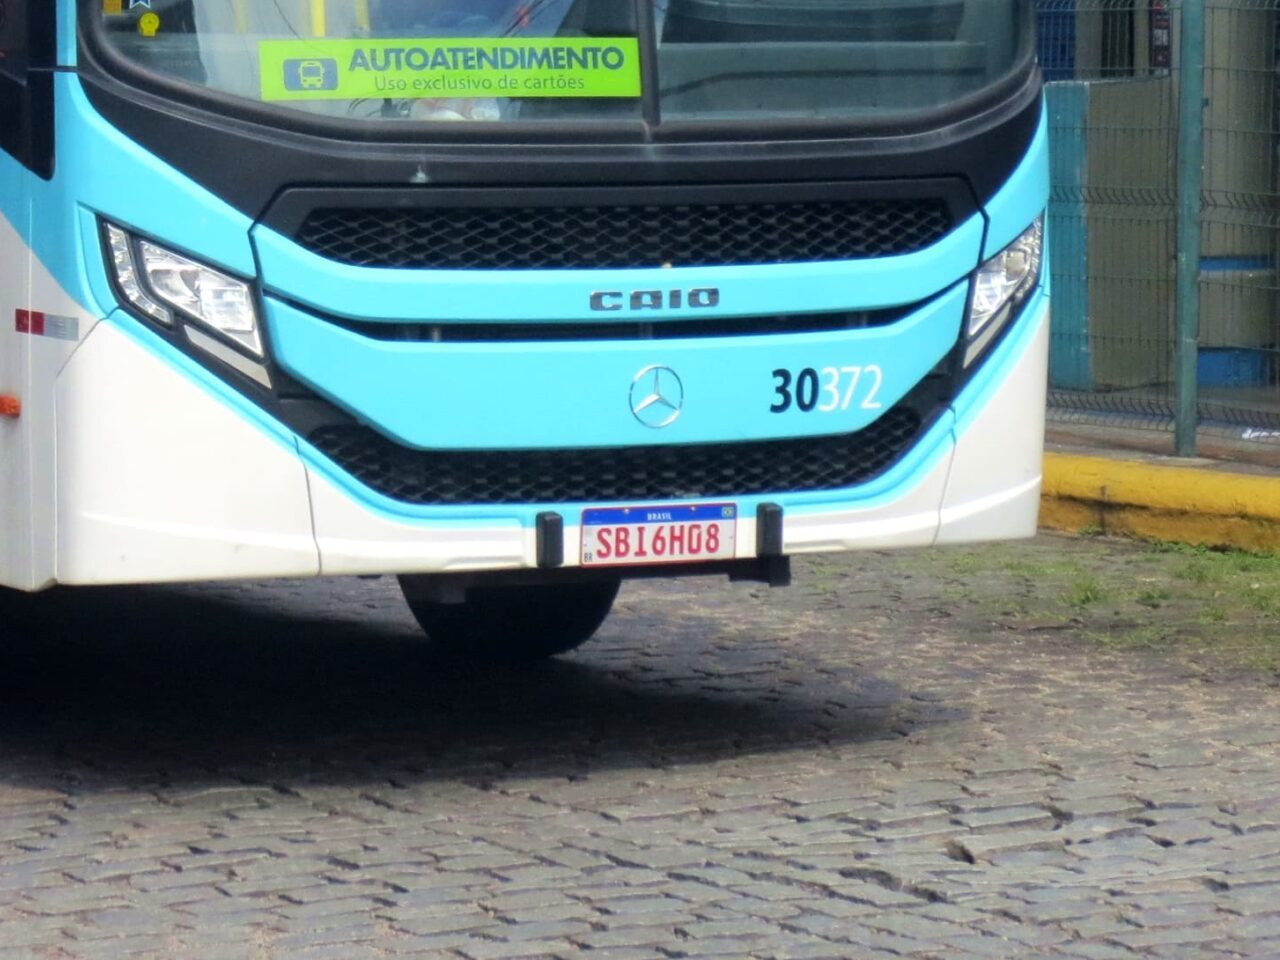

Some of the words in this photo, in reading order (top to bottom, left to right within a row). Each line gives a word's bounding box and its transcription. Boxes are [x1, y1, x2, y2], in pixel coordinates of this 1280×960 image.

[348, 45, 625, 72] AUTOATENDIMENTO
[374, 74, 407, 91] Uso
[412, 73, 494, 91] exclusivo
[498, 73, 517, 90] de
[523, 74, 585, 90] cartões
[589, 287, 720, 312] CAIO
[770, 364, 883, 414] 30372
[646, 512, 672, 521] BRASIL
[596, 522, 720, 559] SBI6H08
